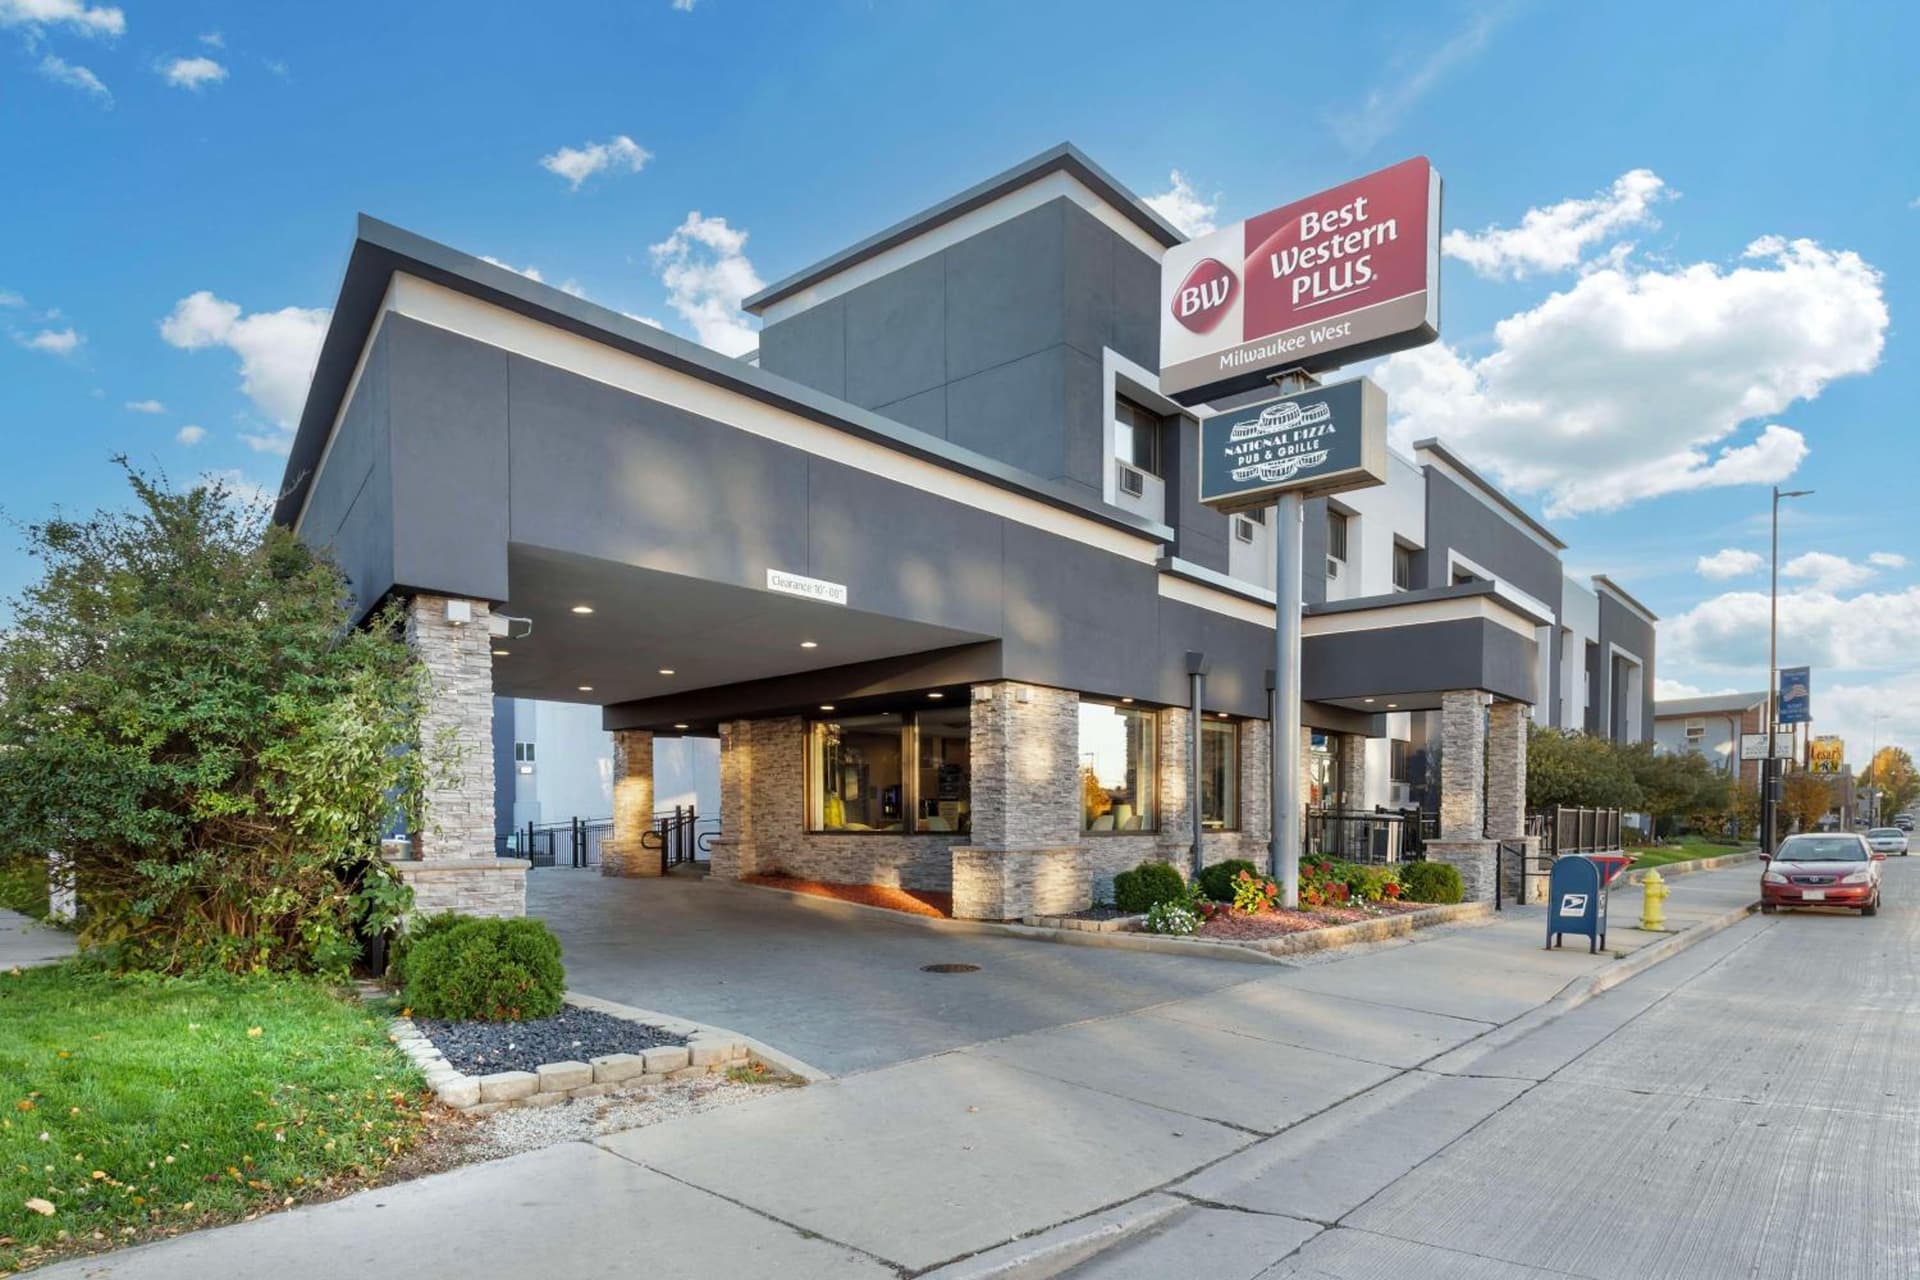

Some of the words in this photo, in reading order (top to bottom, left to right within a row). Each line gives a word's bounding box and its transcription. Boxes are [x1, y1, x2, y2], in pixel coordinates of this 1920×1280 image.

[1300, 196, 1368, 241] Best
[1270, 219, 1398, 279] Western
[1181, 275, 1230, 317] BW
[1219, 334, 1306, 370] Milwaukee
[1309, 322, 1352, 345] West
[1224, 432, 1288, 457] NATIONAL
[1293, 423, 1337, 441] PIZZA
[1238, 452, 1260, 466] PUB
[1264, 448, 1273, 460] &
[1278, 439, 1320, 457] GRILLE
[772, 575, 812, 593] Clearance
